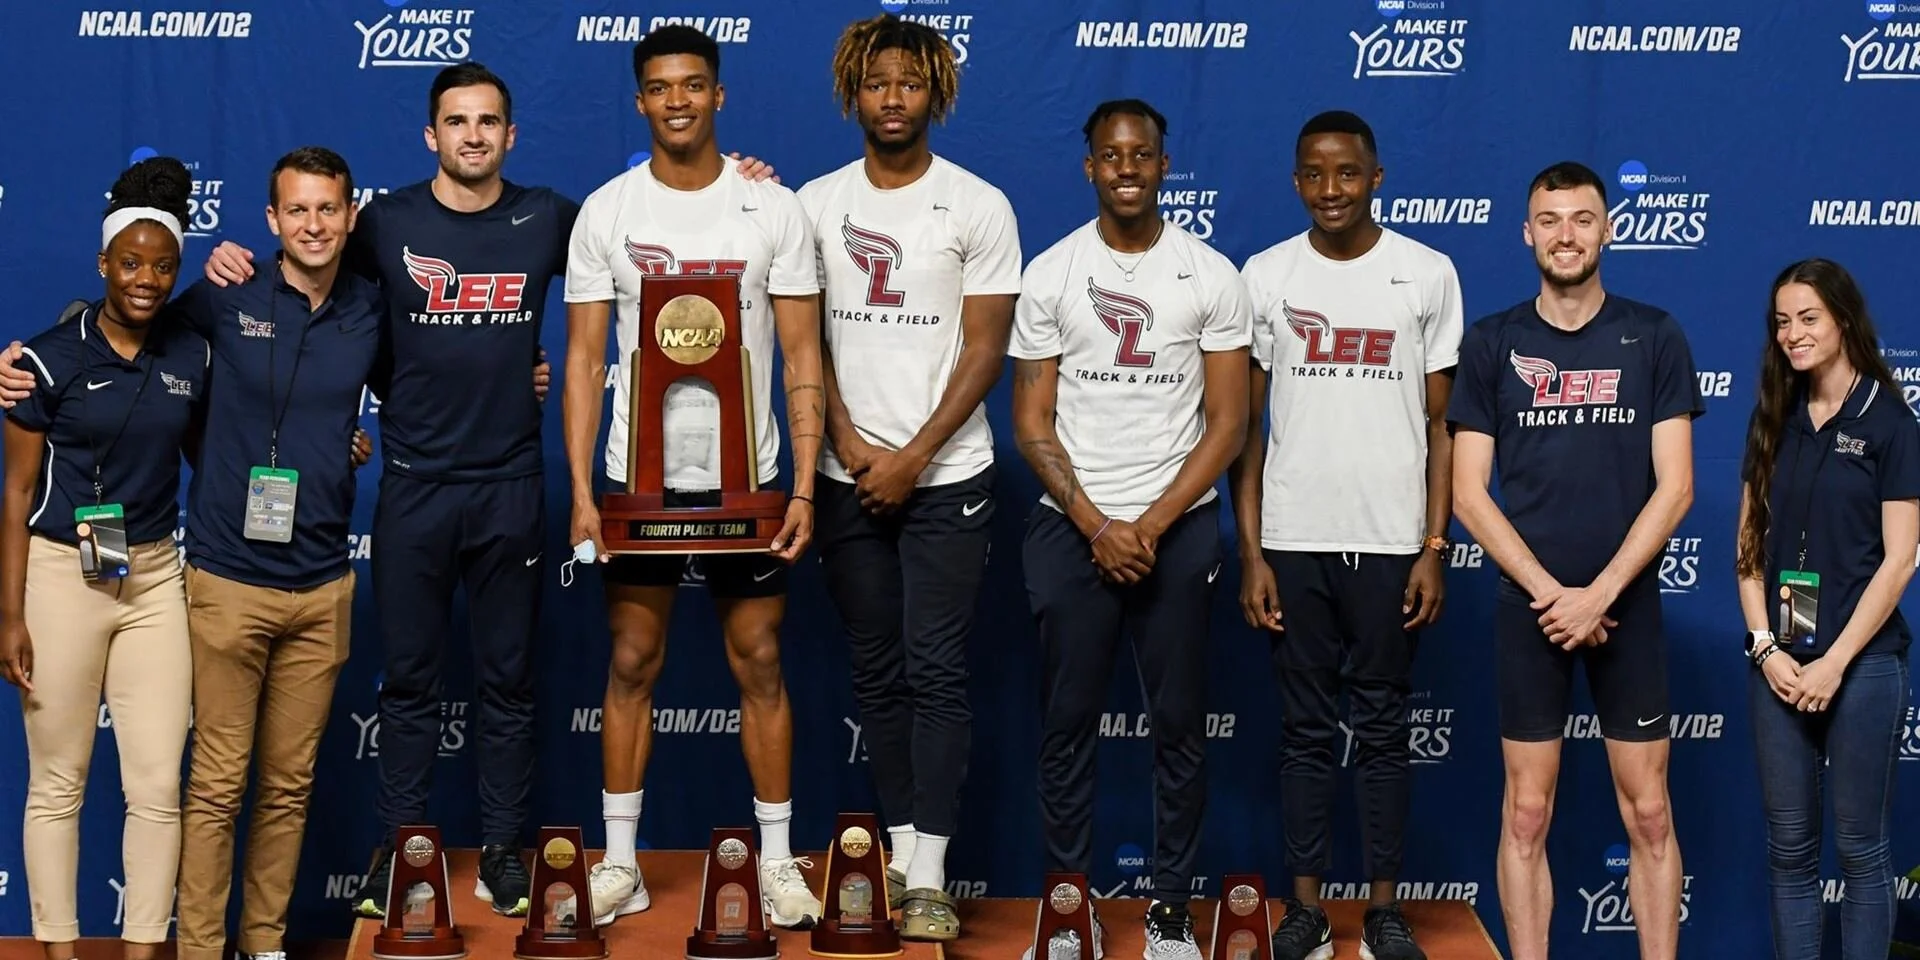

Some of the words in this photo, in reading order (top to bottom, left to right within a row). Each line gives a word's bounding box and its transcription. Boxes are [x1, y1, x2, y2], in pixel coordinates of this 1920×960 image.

[1378, 1, 1404, 9] NCAA
[1407, 1, 1438, 9] Division
[1869, 4, 1895, 13] NCAA
[399, 9, 453, 24] MAKE
[456, 10, 474, 24] IT
[954, 15, 973, 30] IT
[79, 11, 252, 38] NCAA.COM/D2
[1394, 20, 1447, 34] MAKE
[1450, 20, 1468, 34] IT
[354, 14, 472, 69] YOURS
[1075, 22, 1248, 48] NCAA.COM/D2
[1569, 26, 1741, 52] NCAA.COM/D2
[1349, 24, 1465, 79] YOURS
[1620, 175, 1646, 184] NCAA
[1649, 175, 1680, 183] Division
[205, 180, 224, 195] IT
[1200, 190, 1218, 206] IT
[1636, 193, 1689, 208] MAKE
[1692, 193, 1710, 208] IT
[1370, 198, 1492, 224] A.COM/D2
[426, 272, 528, 314] LEE
[409, 312, 464, 325] TRACK
[471, 313, 483, 325] &
[490, 310, 533, 324] FIELD
[832, 309, 873, 323] TRACK
[880, 312, 889, 324] &
[897, 312, 940, 326] FIELD
[661, 328, 722, 348] NCAA
[1304, 327, 1397, 366] LEE
[1887, 348, 1918, 357] Division
[1076, 369, 1119, 383] TRACK
[1128, 373, 1137, 383] &
[1145, 373, 1185, 384] FIELD
[1291, 366, 1338, 379] TRACK
[1346, 368, 1355, 378] &
[1362, 368, 1404, 382] FIELD
[1533, 369, 1621, 407] LEE
[1517, 410, 1568, 428] TRACK
[1575, 409, 1585, 424] &
[1592, 408, 1637, 424] FIELD
[640, 524, 681, 537] FOURTH
[683, 524, 717, 537] PLACE
[720, 523, 747, 536] TEAM
[1684, 538, 1702, 552] IT
[1437, 709, 1454, 723] IT
[1117, 857, 1144, 866] NCAA
